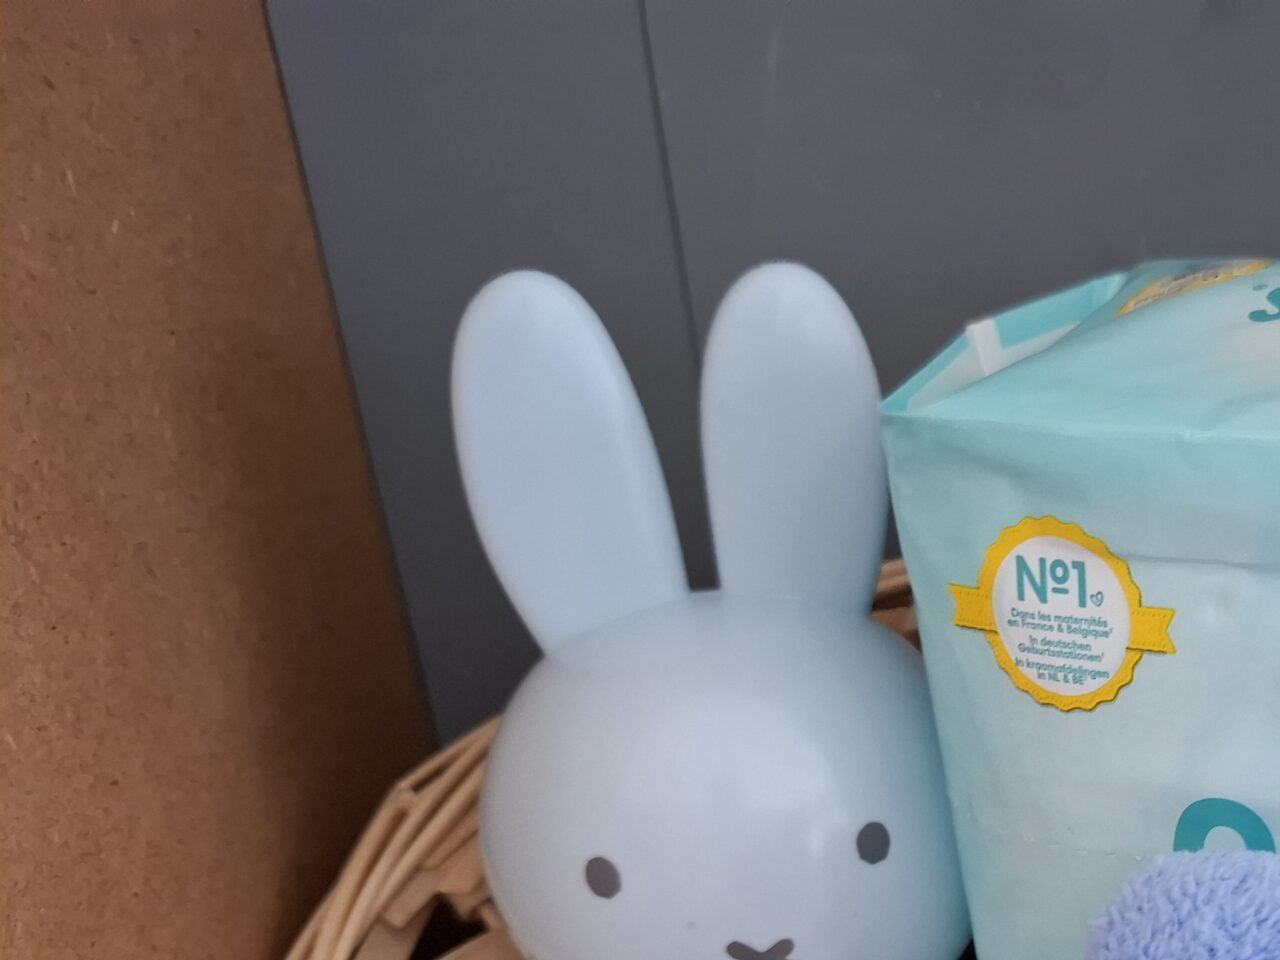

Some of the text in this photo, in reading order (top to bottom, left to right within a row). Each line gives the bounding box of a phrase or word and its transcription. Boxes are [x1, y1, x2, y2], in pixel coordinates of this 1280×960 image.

[1010, 607, 1108, 628] Dans les maternités
[1007, 619, 1020, 627] en
[1021, 619, 1055, 632] France
[1057, 624, 1065, 633] &
[1029, 635, 1092, 651] In deutschen
[1048, 672, 1061, 682] NL
[1063, 675, 1070, 683] &
